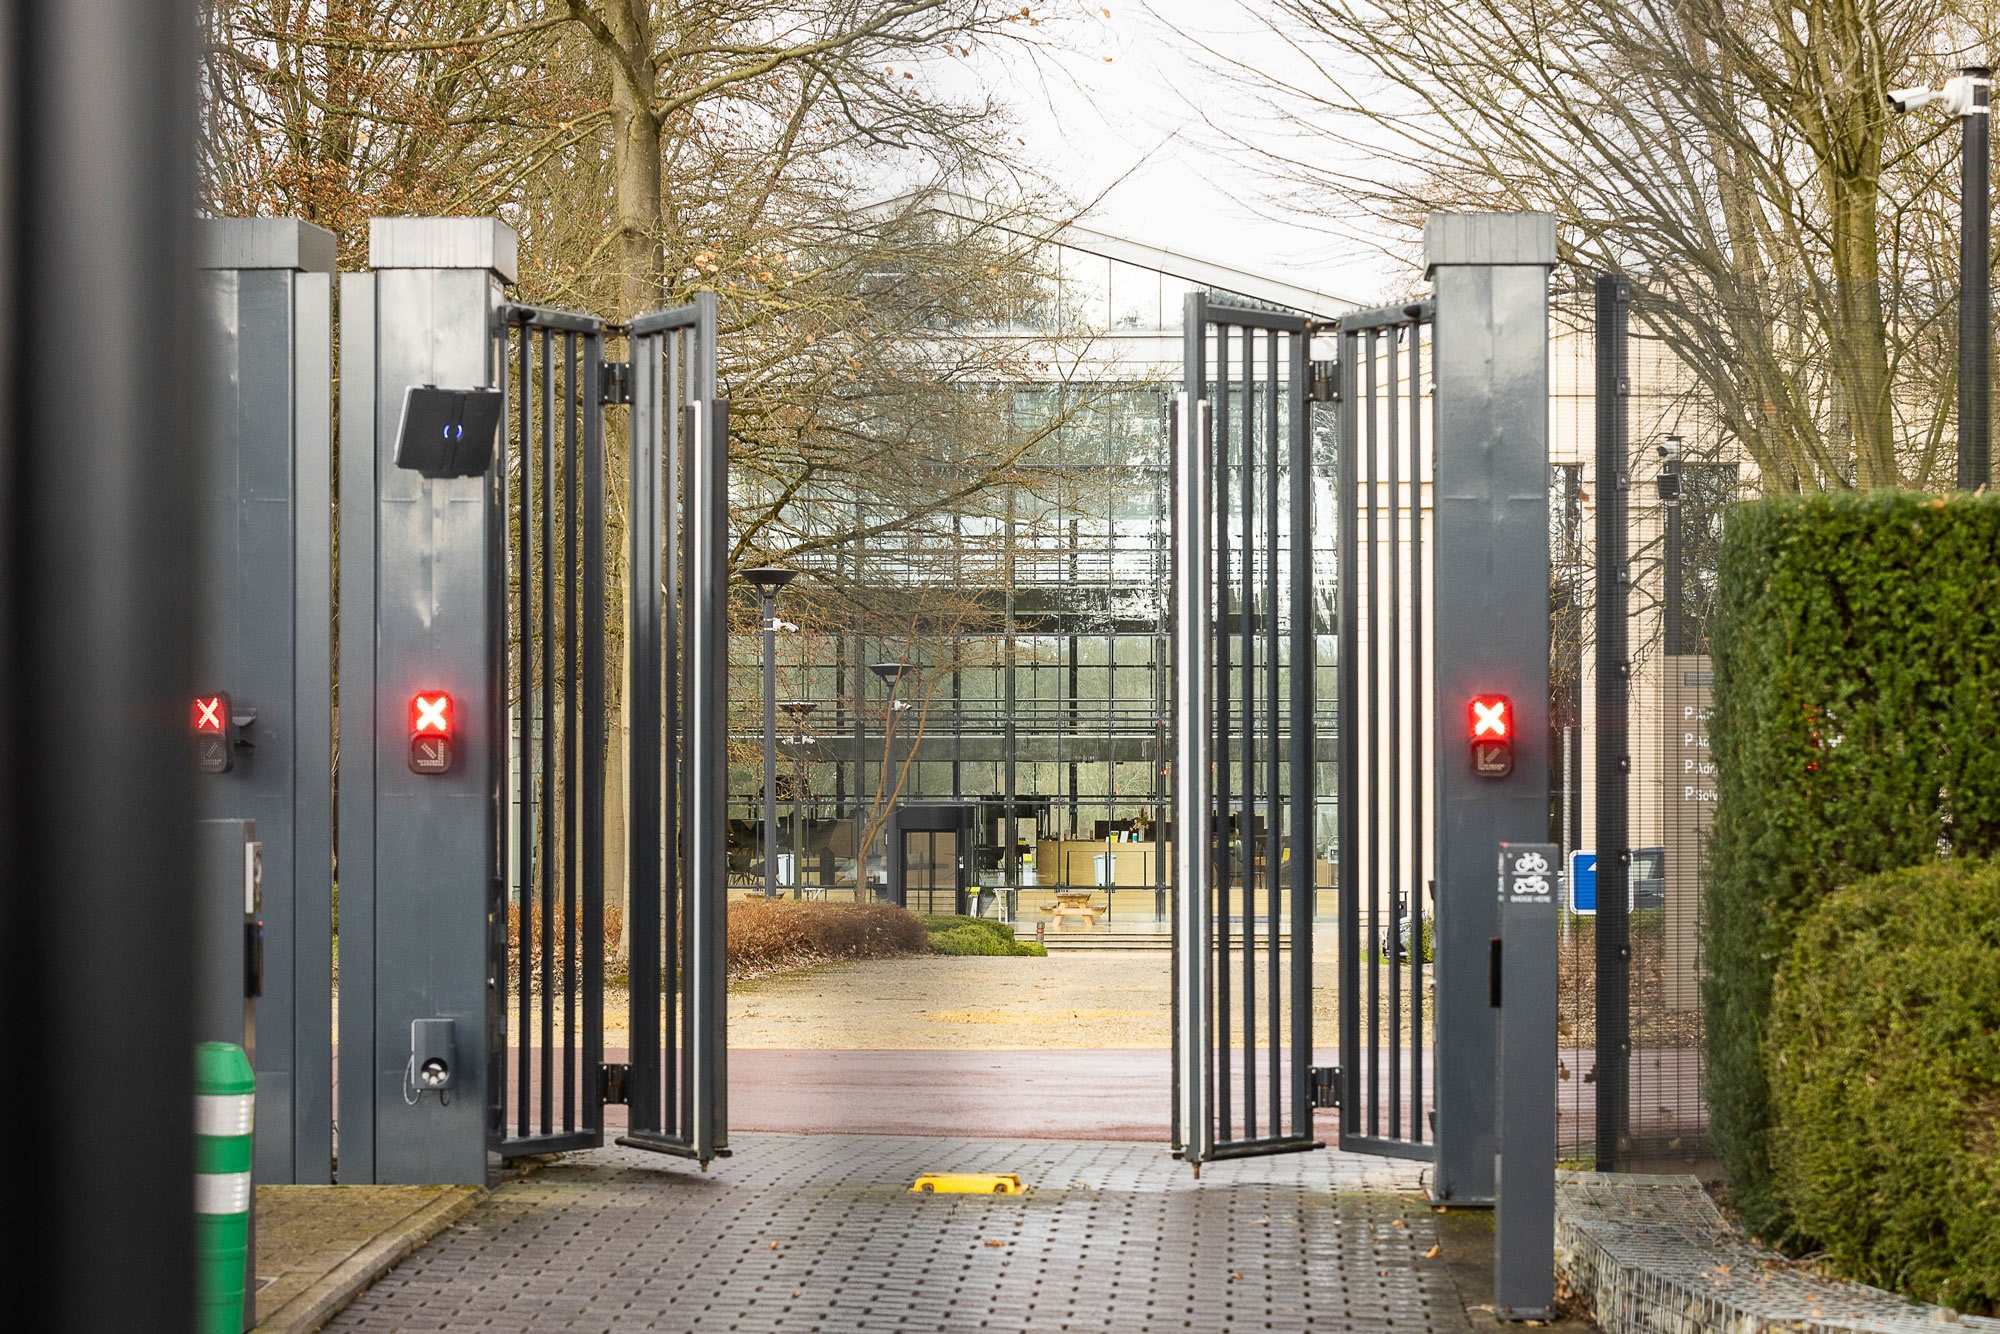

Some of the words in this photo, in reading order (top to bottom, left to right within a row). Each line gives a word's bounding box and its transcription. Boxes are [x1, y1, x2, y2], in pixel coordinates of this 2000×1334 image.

[1684, 733, 1693, 747] P
[1684, 759, 1693, 774] P
[1685, 786, 1694, 801] P
[1696, 789, 1718, 801] Solv
